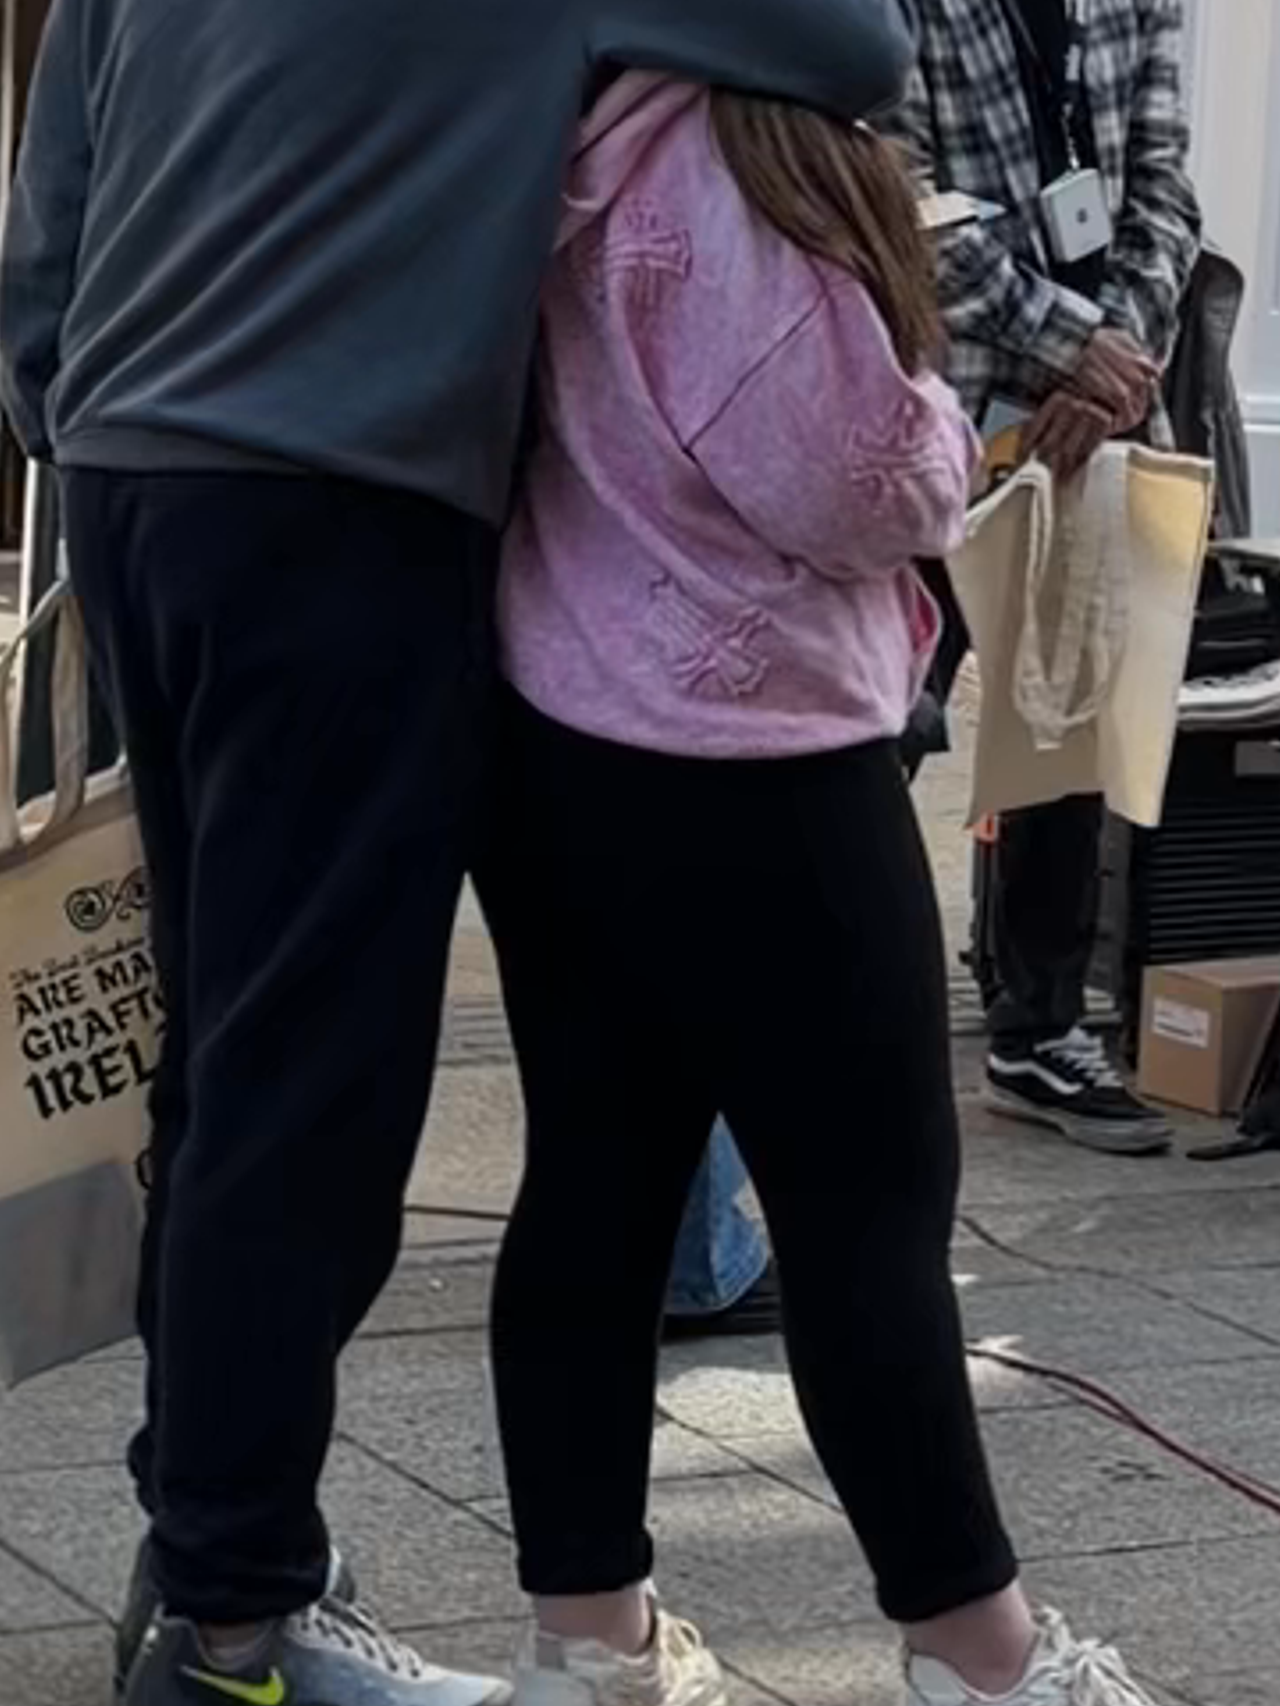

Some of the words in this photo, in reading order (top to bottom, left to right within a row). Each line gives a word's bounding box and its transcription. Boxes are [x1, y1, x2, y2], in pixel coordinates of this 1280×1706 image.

[14, 972, 86, 1026] ARE
[94, 950, 153, 993] MA
[24, 1038, 158, 1120] IREL
